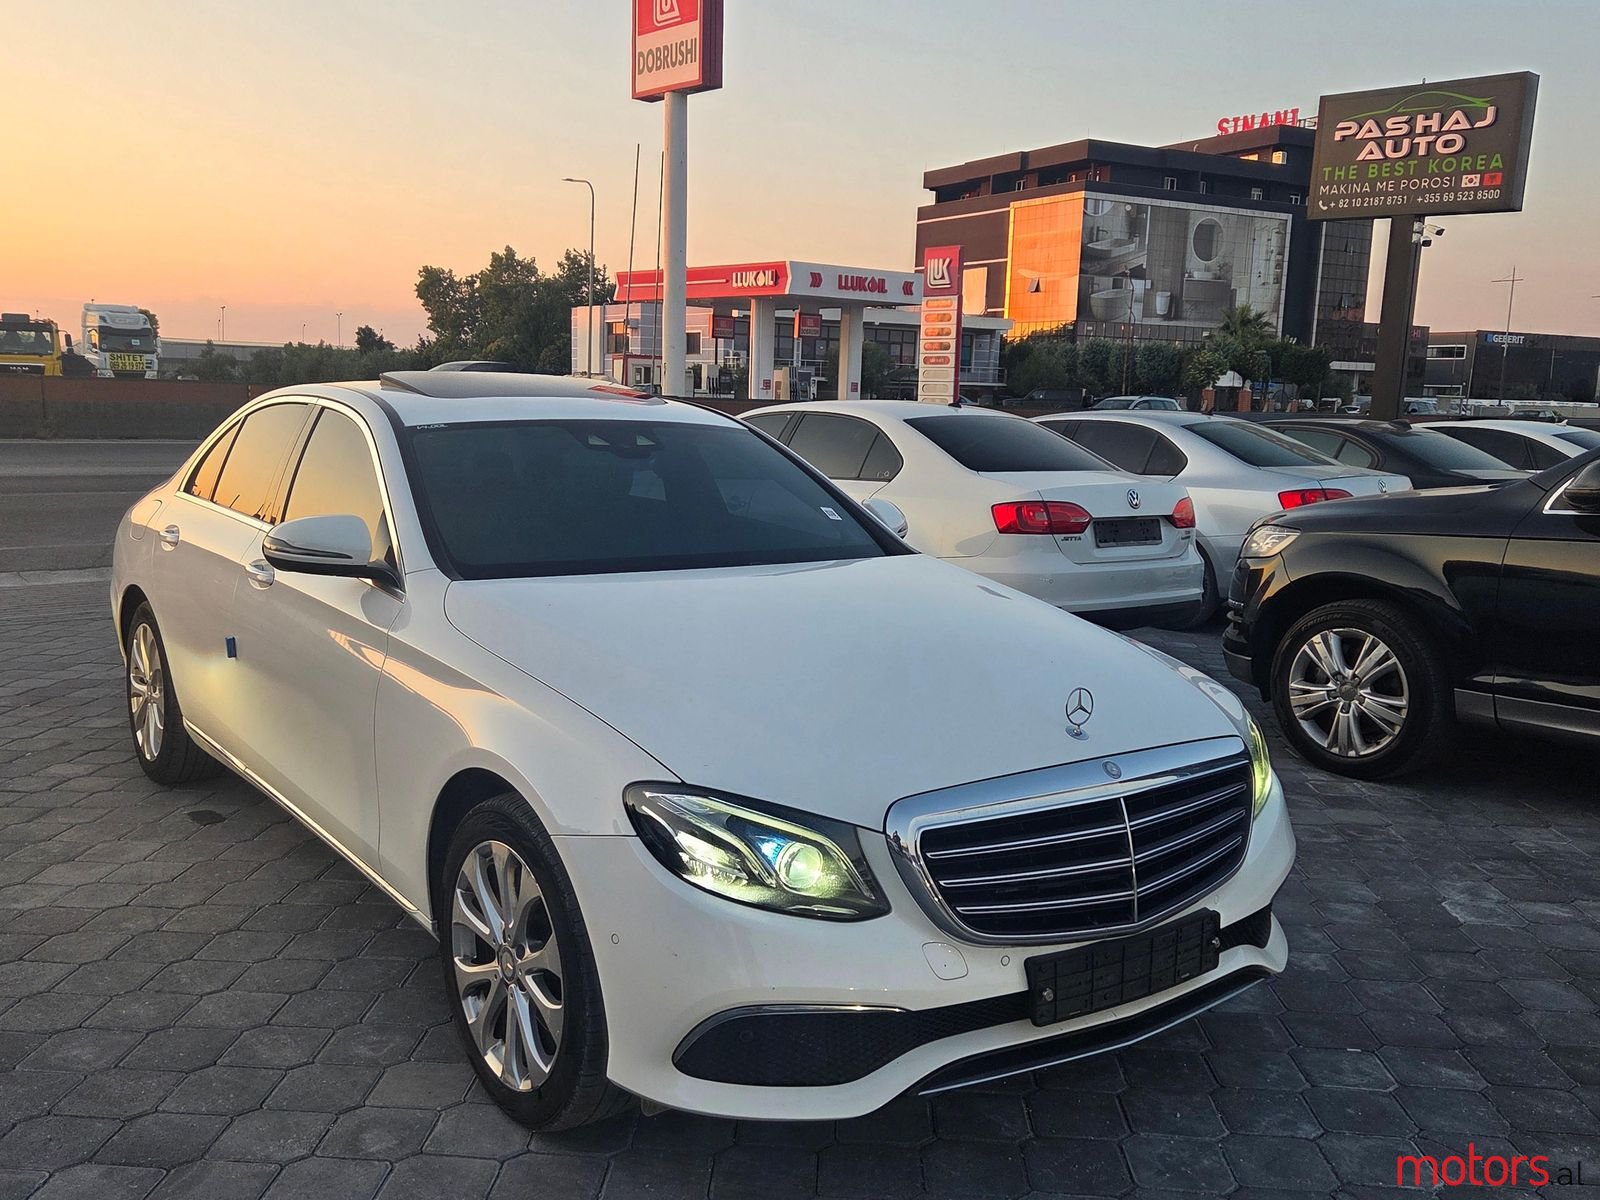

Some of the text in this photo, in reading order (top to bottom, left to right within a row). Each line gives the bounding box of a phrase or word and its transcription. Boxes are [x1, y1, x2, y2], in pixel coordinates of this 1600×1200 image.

[638, 38, 697, 75] DOBRUSHI
[1334, 106, 1497, 141] PASHAJ
[1356, 133, 1465, 160] AUTO
[1323, 153, 1503, 182] THE BEST KOREA
[1319, 176, 1455, 196] MAKINA ME POROSI
[1338, 199, 1349, 208] 82
[1352, 198, 1362, 207] 10
[1363, 197, 1385, 207] 2187
[1386, 195, 1407, 206] 8751
[1416, 193, 1441, 203] +355
[1443, 192, 1455, 202] 69
[1457, 191, 1474, 201] 523
[1476, 189, 1501, 200] 8500
[732, 269, 775, 288] LLUKOIL
[838, 274, 888, 293] LLUKOIL
[1492, 334, 1525, 344] GEBERIT
[109, 353, 144, 362] SHITET
